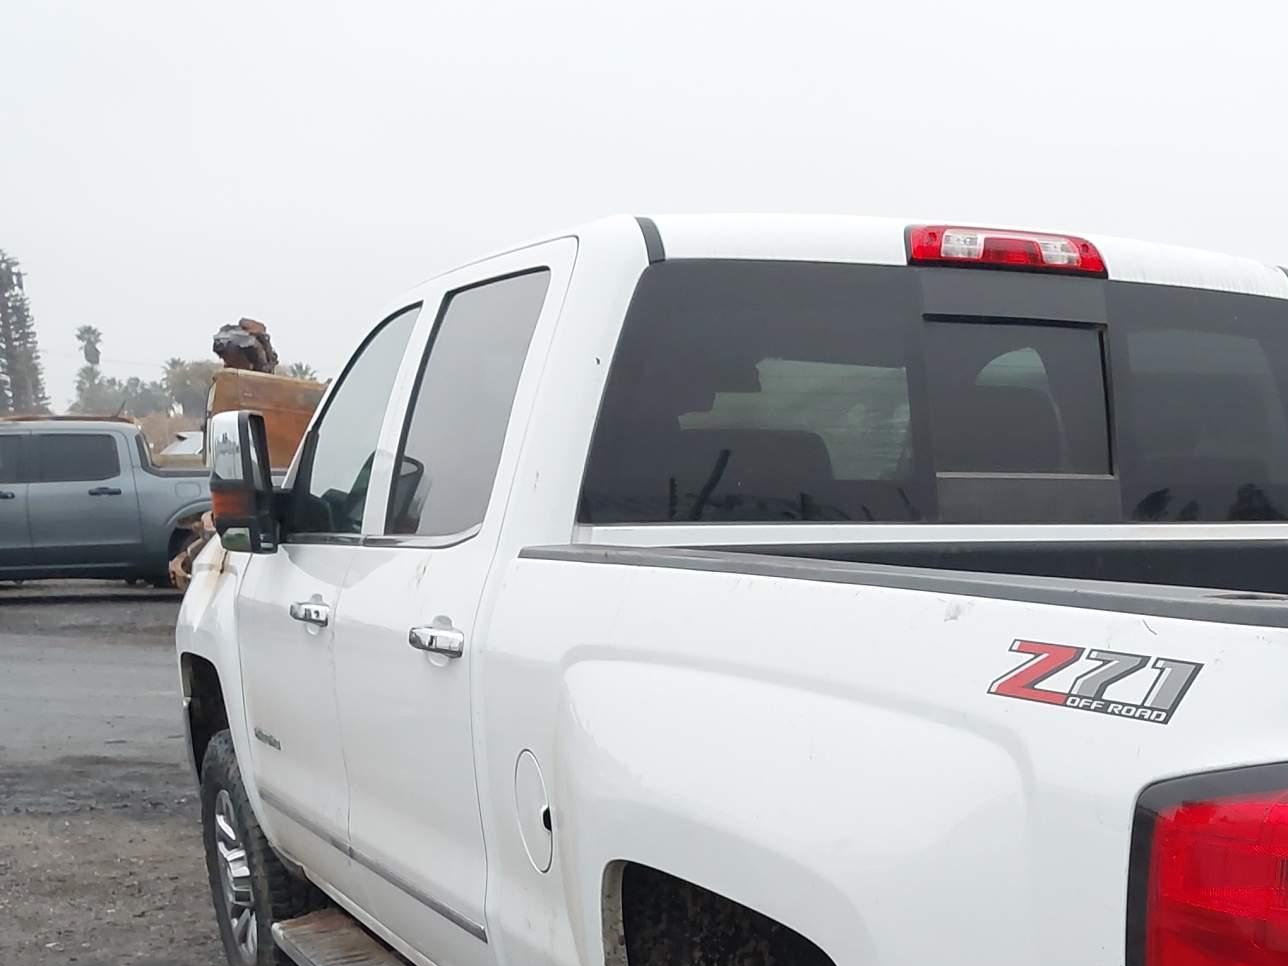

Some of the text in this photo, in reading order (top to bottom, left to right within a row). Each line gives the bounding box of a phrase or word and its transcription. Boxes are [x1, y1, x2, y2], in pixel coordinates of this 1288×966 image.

[987, 639, 1204, 711] Z71
[1066, 697, 1167, 722] OFF ROAD
